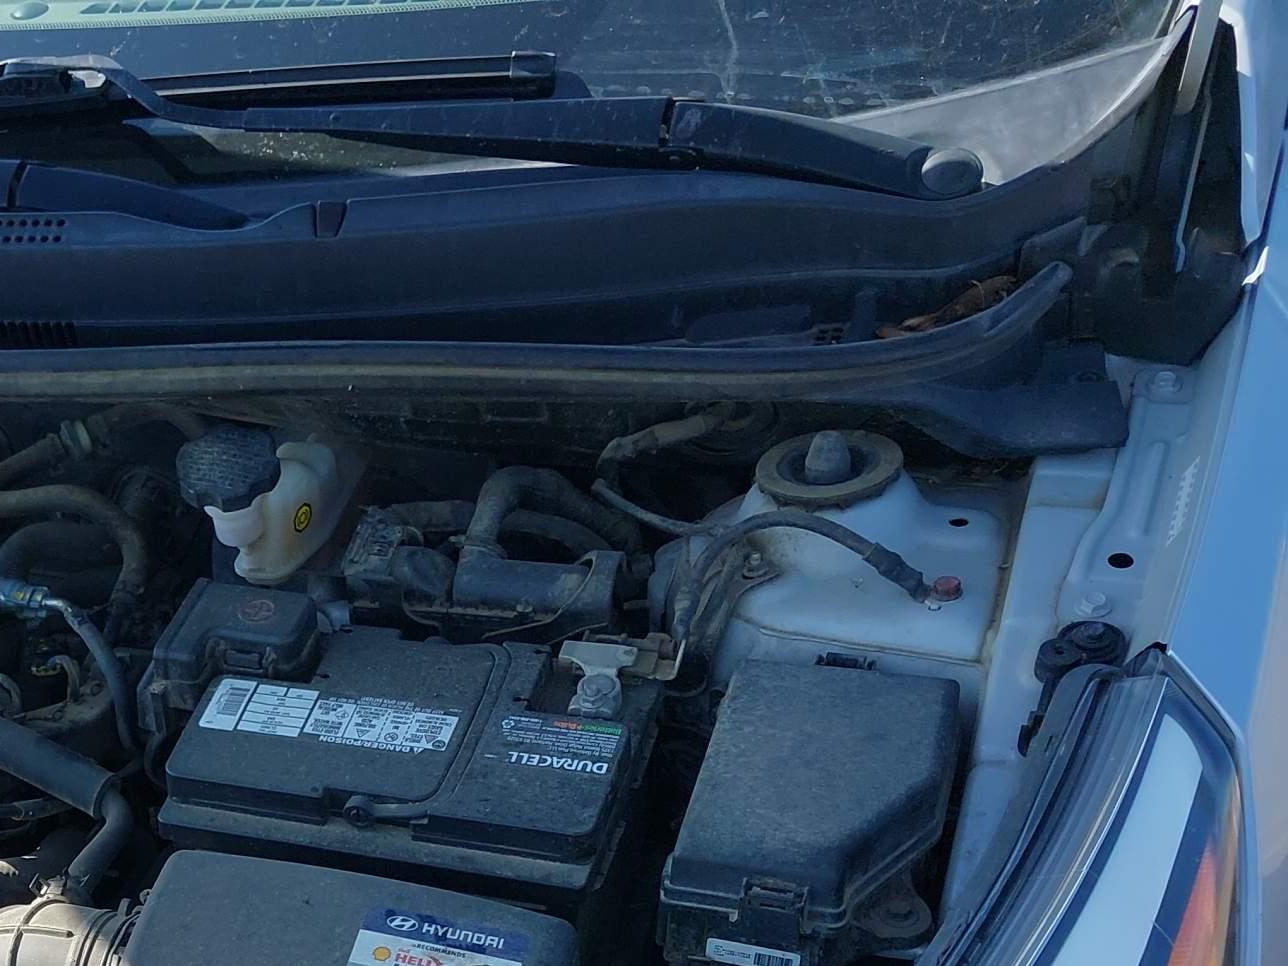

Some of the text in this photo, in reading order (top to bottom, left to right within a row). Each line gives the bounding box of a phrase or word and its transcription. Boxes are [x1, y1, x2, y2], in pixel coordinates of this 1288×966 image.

[318, 735, 410, 753] DANGER/POISON
[508, 751, 609, 774] DURACELL
[421, 922, 505, 949] HYUNDAI
